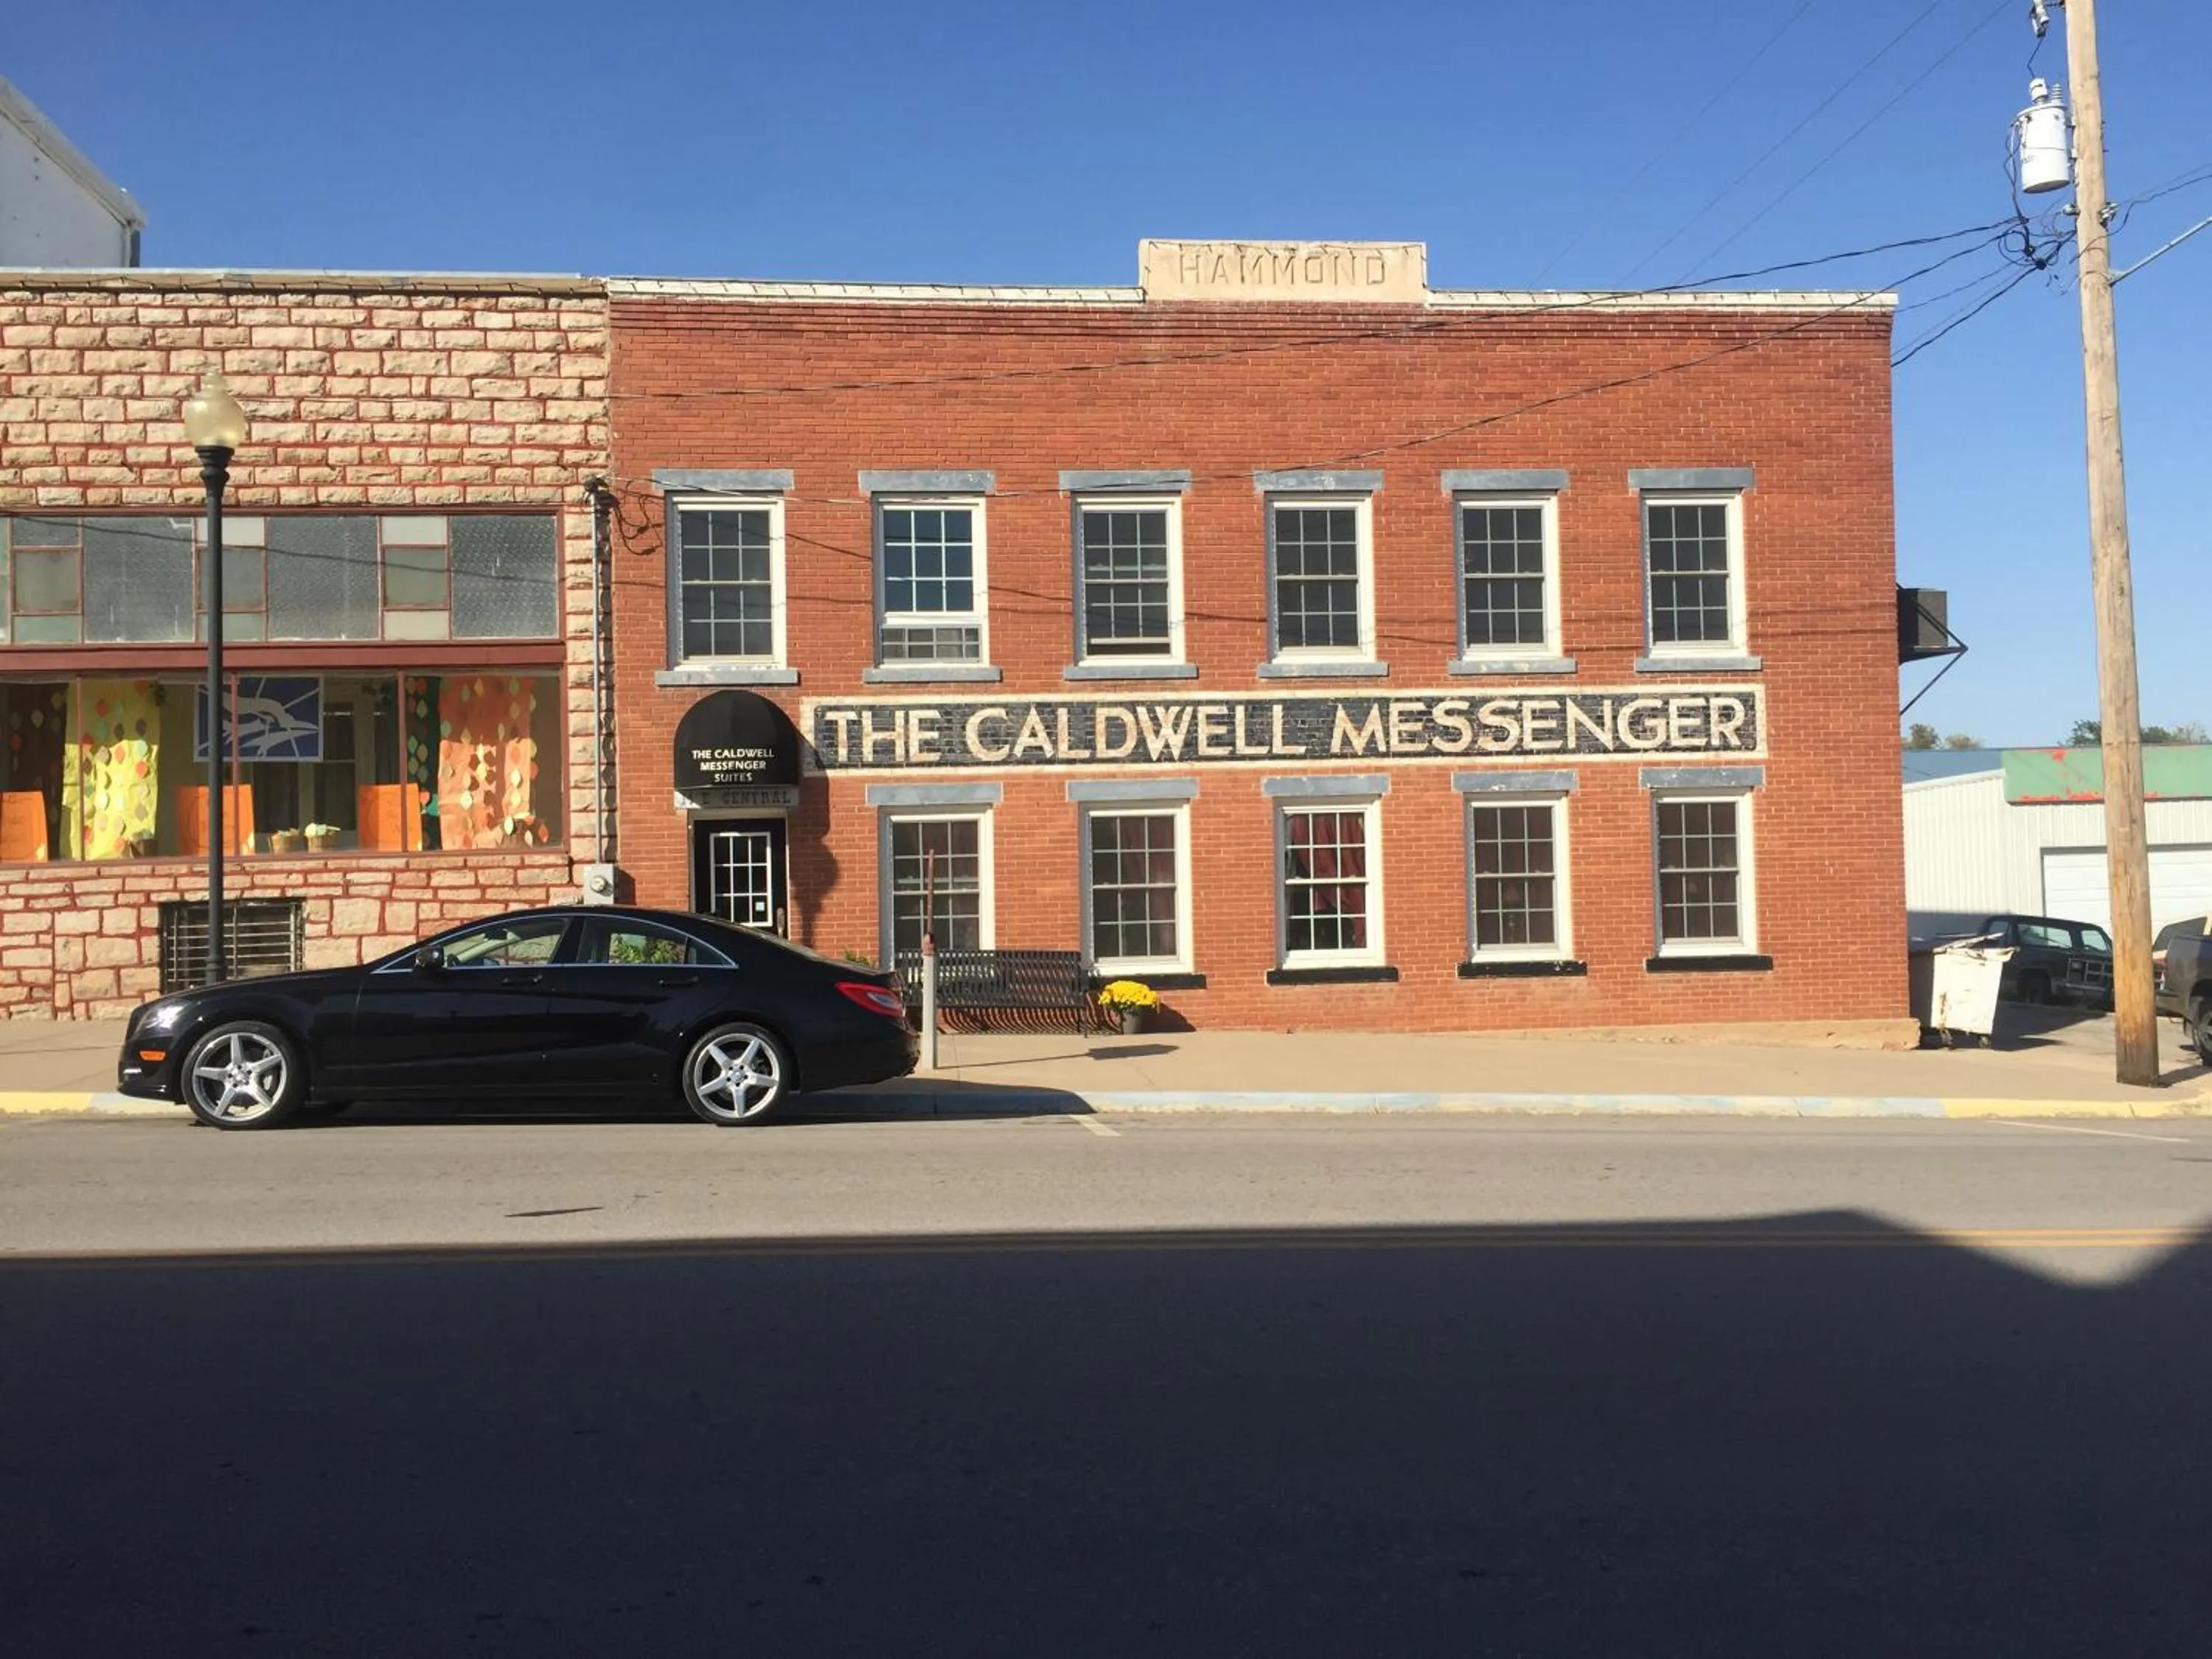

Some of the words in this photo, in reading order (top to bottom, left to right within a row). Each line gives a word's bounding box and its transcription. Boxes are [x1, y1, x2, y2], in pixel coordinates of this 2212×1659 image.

[1179, 253, 1386, 285] HAMMOND
[824, 708, 942, 762] THE
[964, 703, 1307, 762] CALDWELL
[1329, 696, 1745, 757] MESSENGER
[692, 749, 712, 759] THE
[714, 748, 774, 759] CALDWELL
[700, 760, 767, 771] MESSENGER
[714, 772, 753, 783] SUITES
[722, 790, 791, 805] CENTRAL
